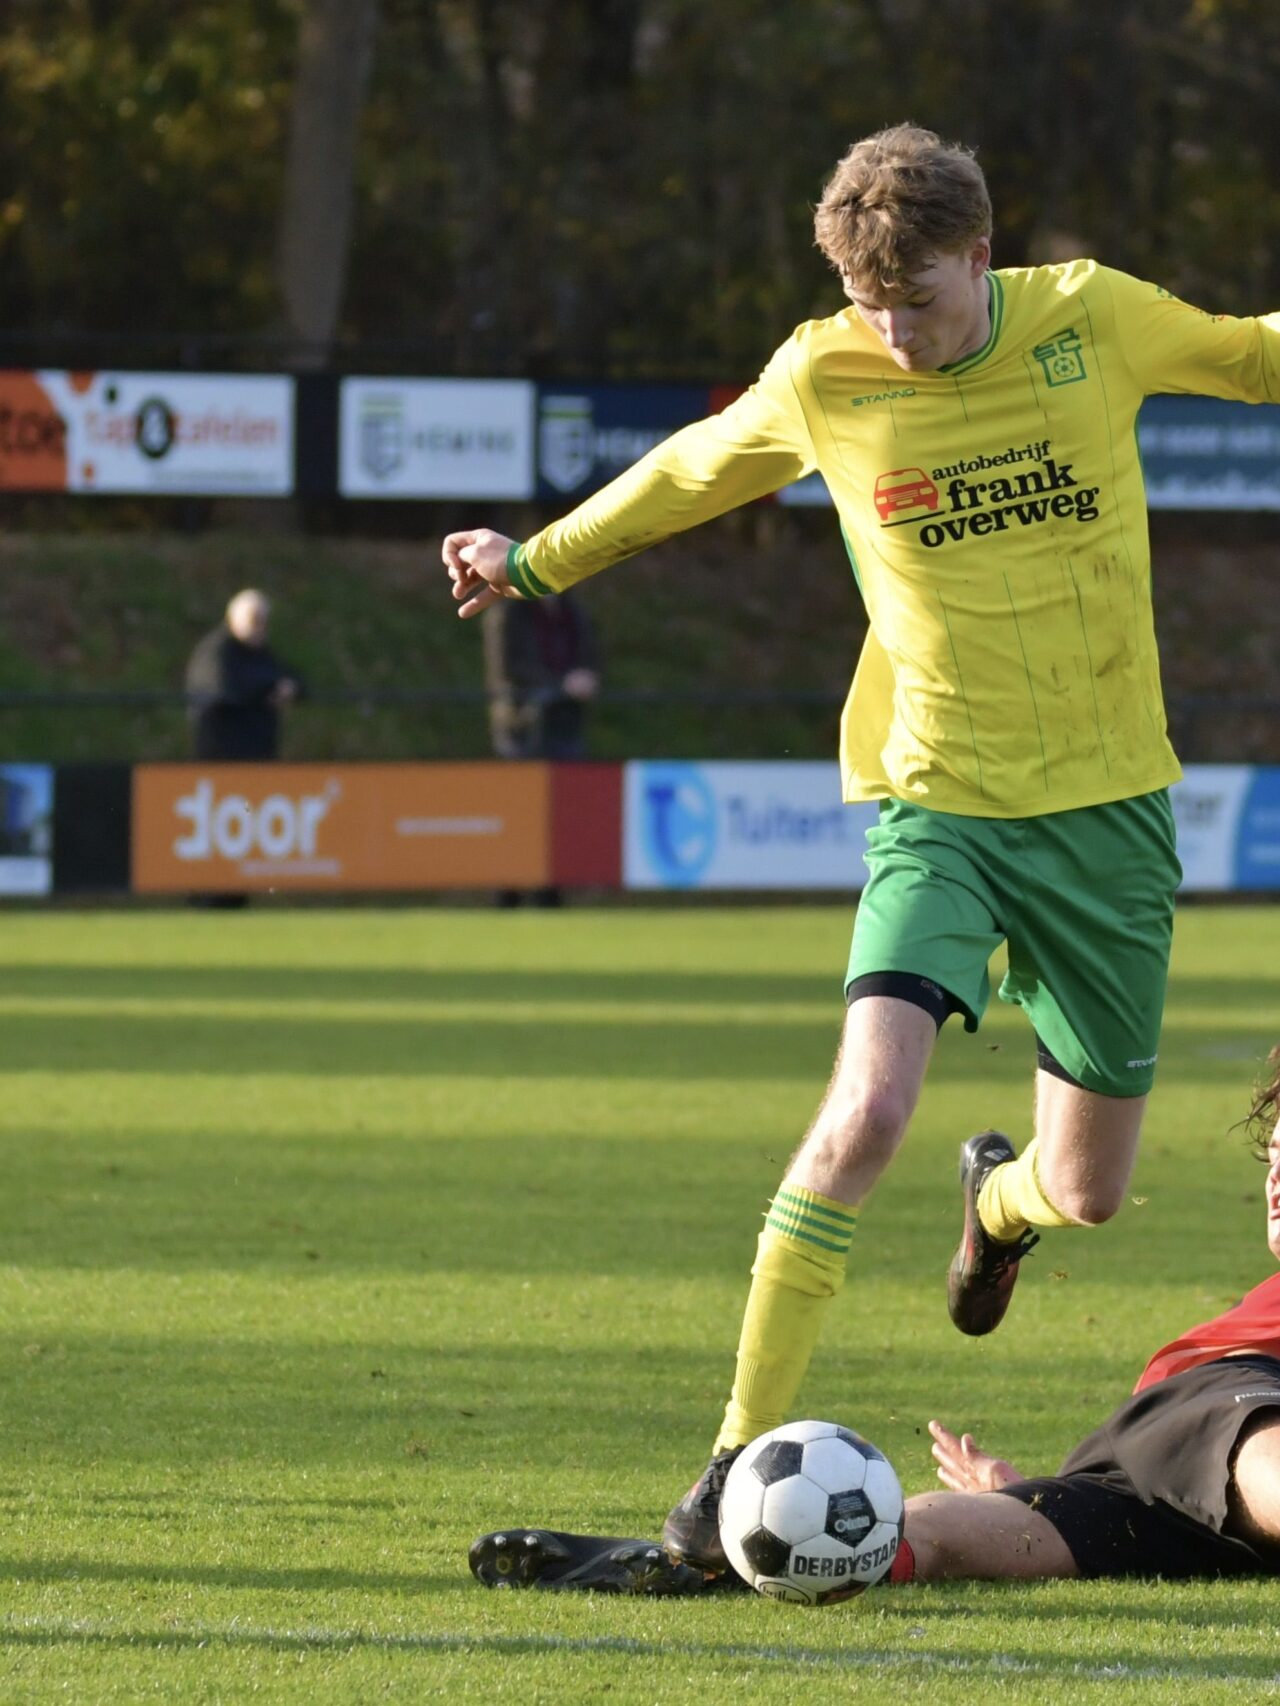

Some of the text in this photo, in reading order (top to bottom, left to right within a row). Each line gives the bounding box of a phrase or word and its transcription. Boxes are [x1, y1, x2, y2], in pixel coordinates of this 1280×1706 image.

[851, 387, 917, 407] STANNO
[932, 440, 1051, 481] autobedrijf
[946, 459, 1078, 513] frank
[919, 487, 1099, 547] overweg
[173, 778, 329, 860] door
[793, 1536, 897, 1577] DERBYSTAR
